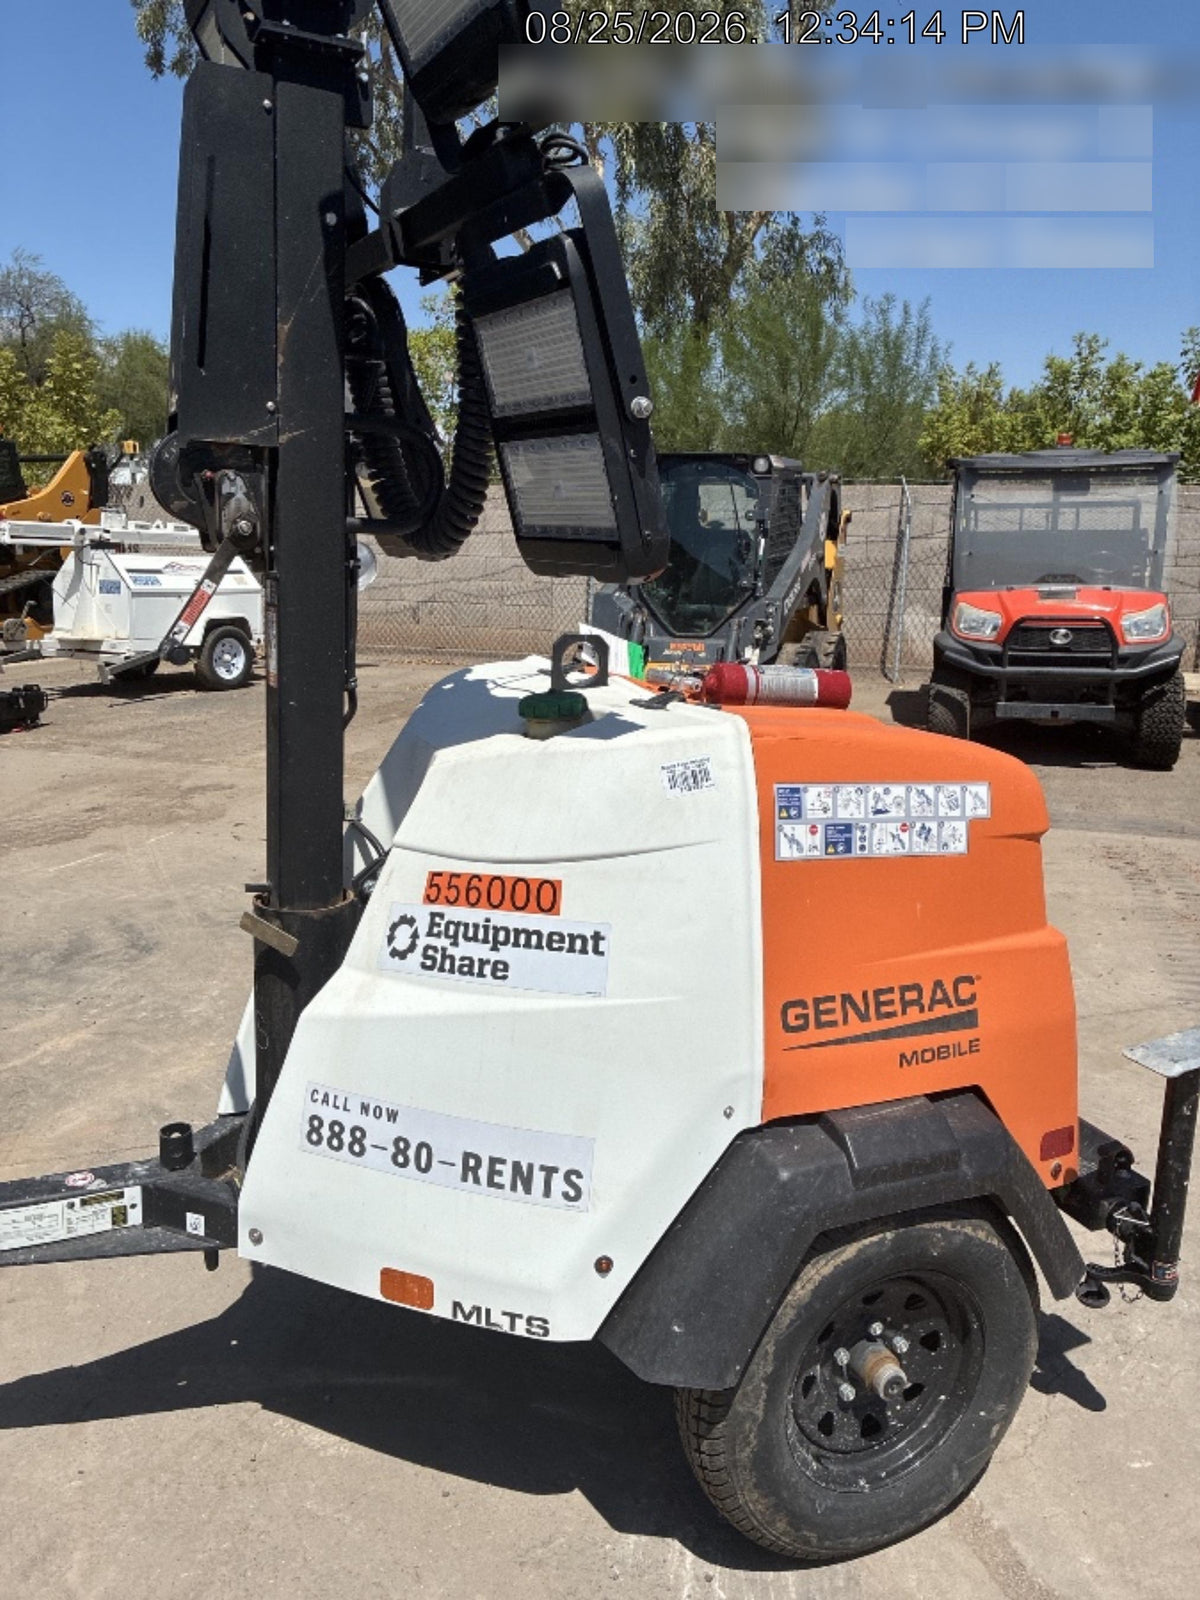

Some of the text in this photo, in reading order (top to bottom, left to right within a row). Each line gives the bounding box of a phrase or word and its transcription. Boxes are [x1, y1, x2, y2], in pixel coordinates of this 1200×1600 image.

[425, 871, 559, 914] 556000
[425, 910, 606, 957] Equipment
[419, 943, 510, 981] Share
[780, 974, 978, 1034] GENERAC
[898, 1037, 982, 1069] MOBILE
[309, 1088, 400, 1125] CALL NOW
[305, 1113, 585, 1203] 888-80-RENTS
[451, 1299, 551, 1338] MLTS
